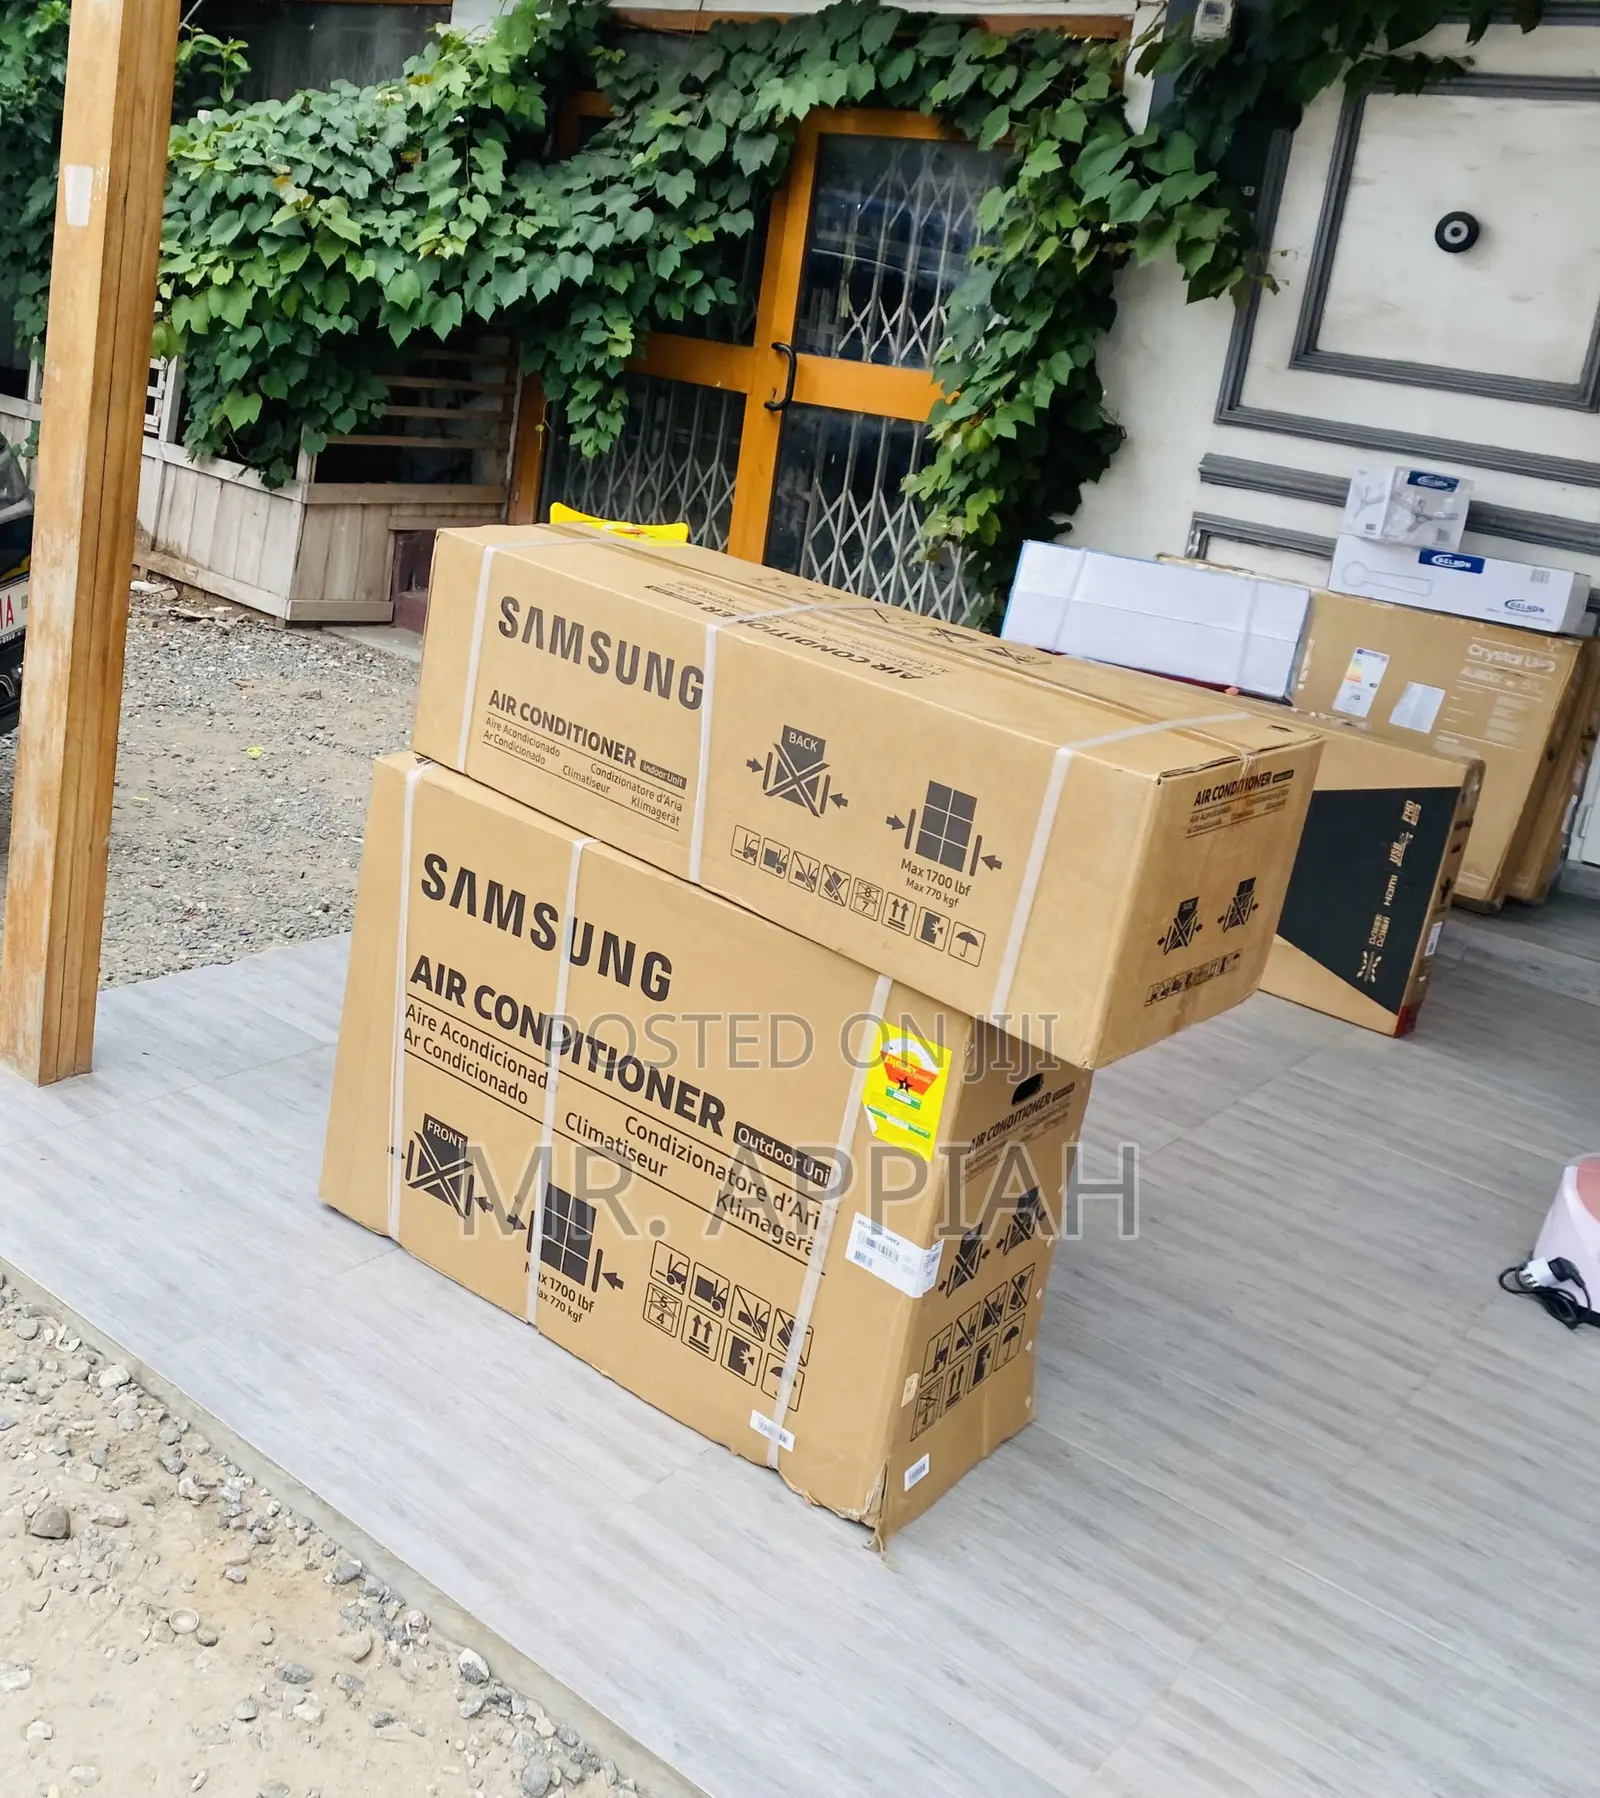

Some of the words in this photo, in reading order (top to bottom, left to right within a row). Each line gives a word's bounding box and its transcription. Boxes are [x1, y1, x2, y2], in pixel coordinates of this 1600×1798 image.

[499, 596, 705, 710] SAMSUNG
[870, 662, 923, 680] AIR
[1467, 642, 1523, 666] Crystal
[483, 730, 494, 743] Ar
[494, 735, 546, 765] Condicionado
[485, 716, 502, 731] Aire
[502, 721, 560, 758] Acondicionado
[488, 689, 516, 716] AIR
[519, 703, 637, 769] CONDITIONER
[642, 761, 667, 779] Indoor
[667, 772, 685, 787] Unit
[788, 731, 818, 752] BACK
[562, 764, 610, 794] Climatiseur
[590, 763, 655, 800] Condizionatore
[1193, 786, 1212, 807] AIR
[1212, 771, 1272, 801] CONDITIONER
[631, 796, 680, 826] Klimagerät
[901, 858, 925, 878] Max
[926, 868, 953, 890] 1700
[955, 879, 972, 897] lbf
[905, 877, 924, 895] Max
[925, 885, 942, 901] 770
[943, 891, 959, 909] kgf
[421, 853, 673, 1002] SAMSUNG
[405, 1003, 437, 1031] Aire
[404, 1027, 421, 1047] Ar
[423, 1037, 528, 1104] Condicionado
[410, 955, 466, 1008] AIR
[474, 984, 727, 1136] CONDITIONER
[738, 1127, 801, 1169] Outdoor
[802, 1158, 830, 1185] Uni
[426, 1120, 464, 1149] FRONT
[565, 1112, 668, 1177] Climatiseur
[625, 1115, 768, 1202] Condizionatore
[773, 1192, 820, 1230] d'Ari
[716, 1190, 814, 1256] Klimagerä
[549, 1277, 576, 1303] 1700
[577, 1293, 595, 1313] lbf
[550, 1295, 566, 1313] 770
[567, 1305, 583, 1323] kgf
